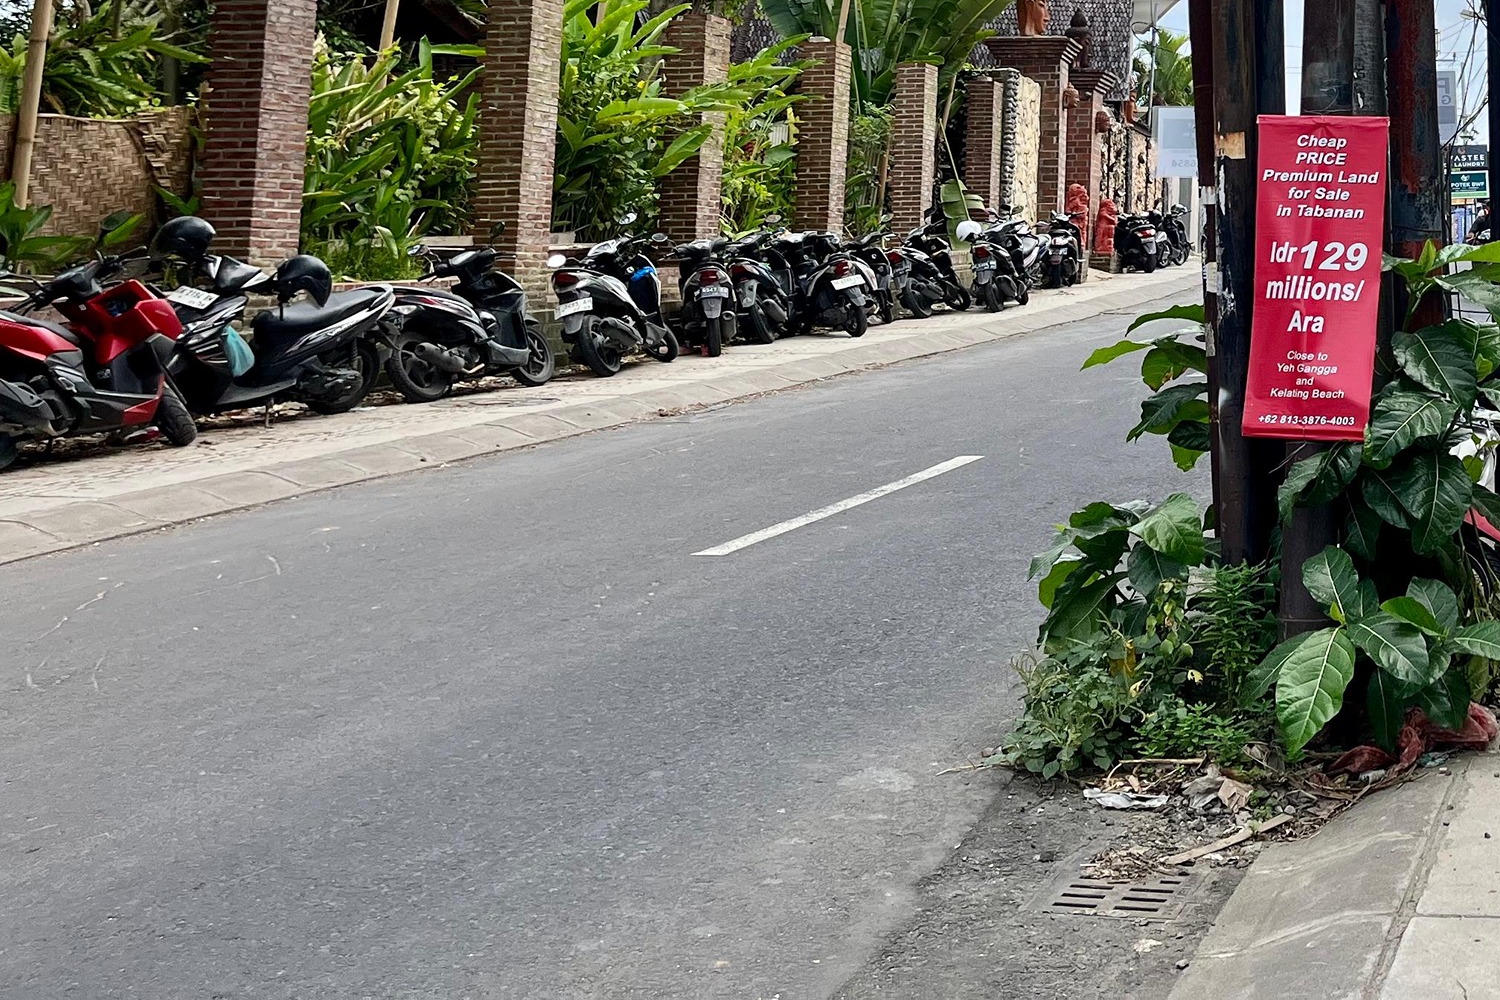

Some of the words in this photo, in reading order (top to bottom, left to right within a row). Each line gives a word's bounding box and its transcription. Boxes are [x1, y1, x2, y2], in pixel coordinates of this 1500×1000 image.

[1296, 134, 1347, 150] Cheap
[1295, 152, 1347, 165] PRICE
[1262, 169, 1333, 182] Premium
[1338, 170, 1379, 184] Land
[1287, 187, 1311, 199] for
[1314, 187, 1350, 201] Sale
[1276, 204, 1292, 217] in
[1297, 204, 1365, 219] Tabanan
[1270, 241, 1298, 264] Idr
[1299, 240, 1369, 272] 129
[1265, 275, 1366, 302] millions/
[1287, 310, 1325, 333] Ara
[1286, 351, 1315, 361] Close
[1317, 351, 1328, 361] to
[1277, 363, 1295, 373] Yeh
[1297, 364, 1338, 376] Gangga
[1295, 377, 1315, 386] and
[1270, 388, 1309, 400] Kelating
[1311, 389, 1345, 399] Beach
[1259, 415, 1278, 424] +62
[1280, 416, 1355, 426] 813-3876-4003
